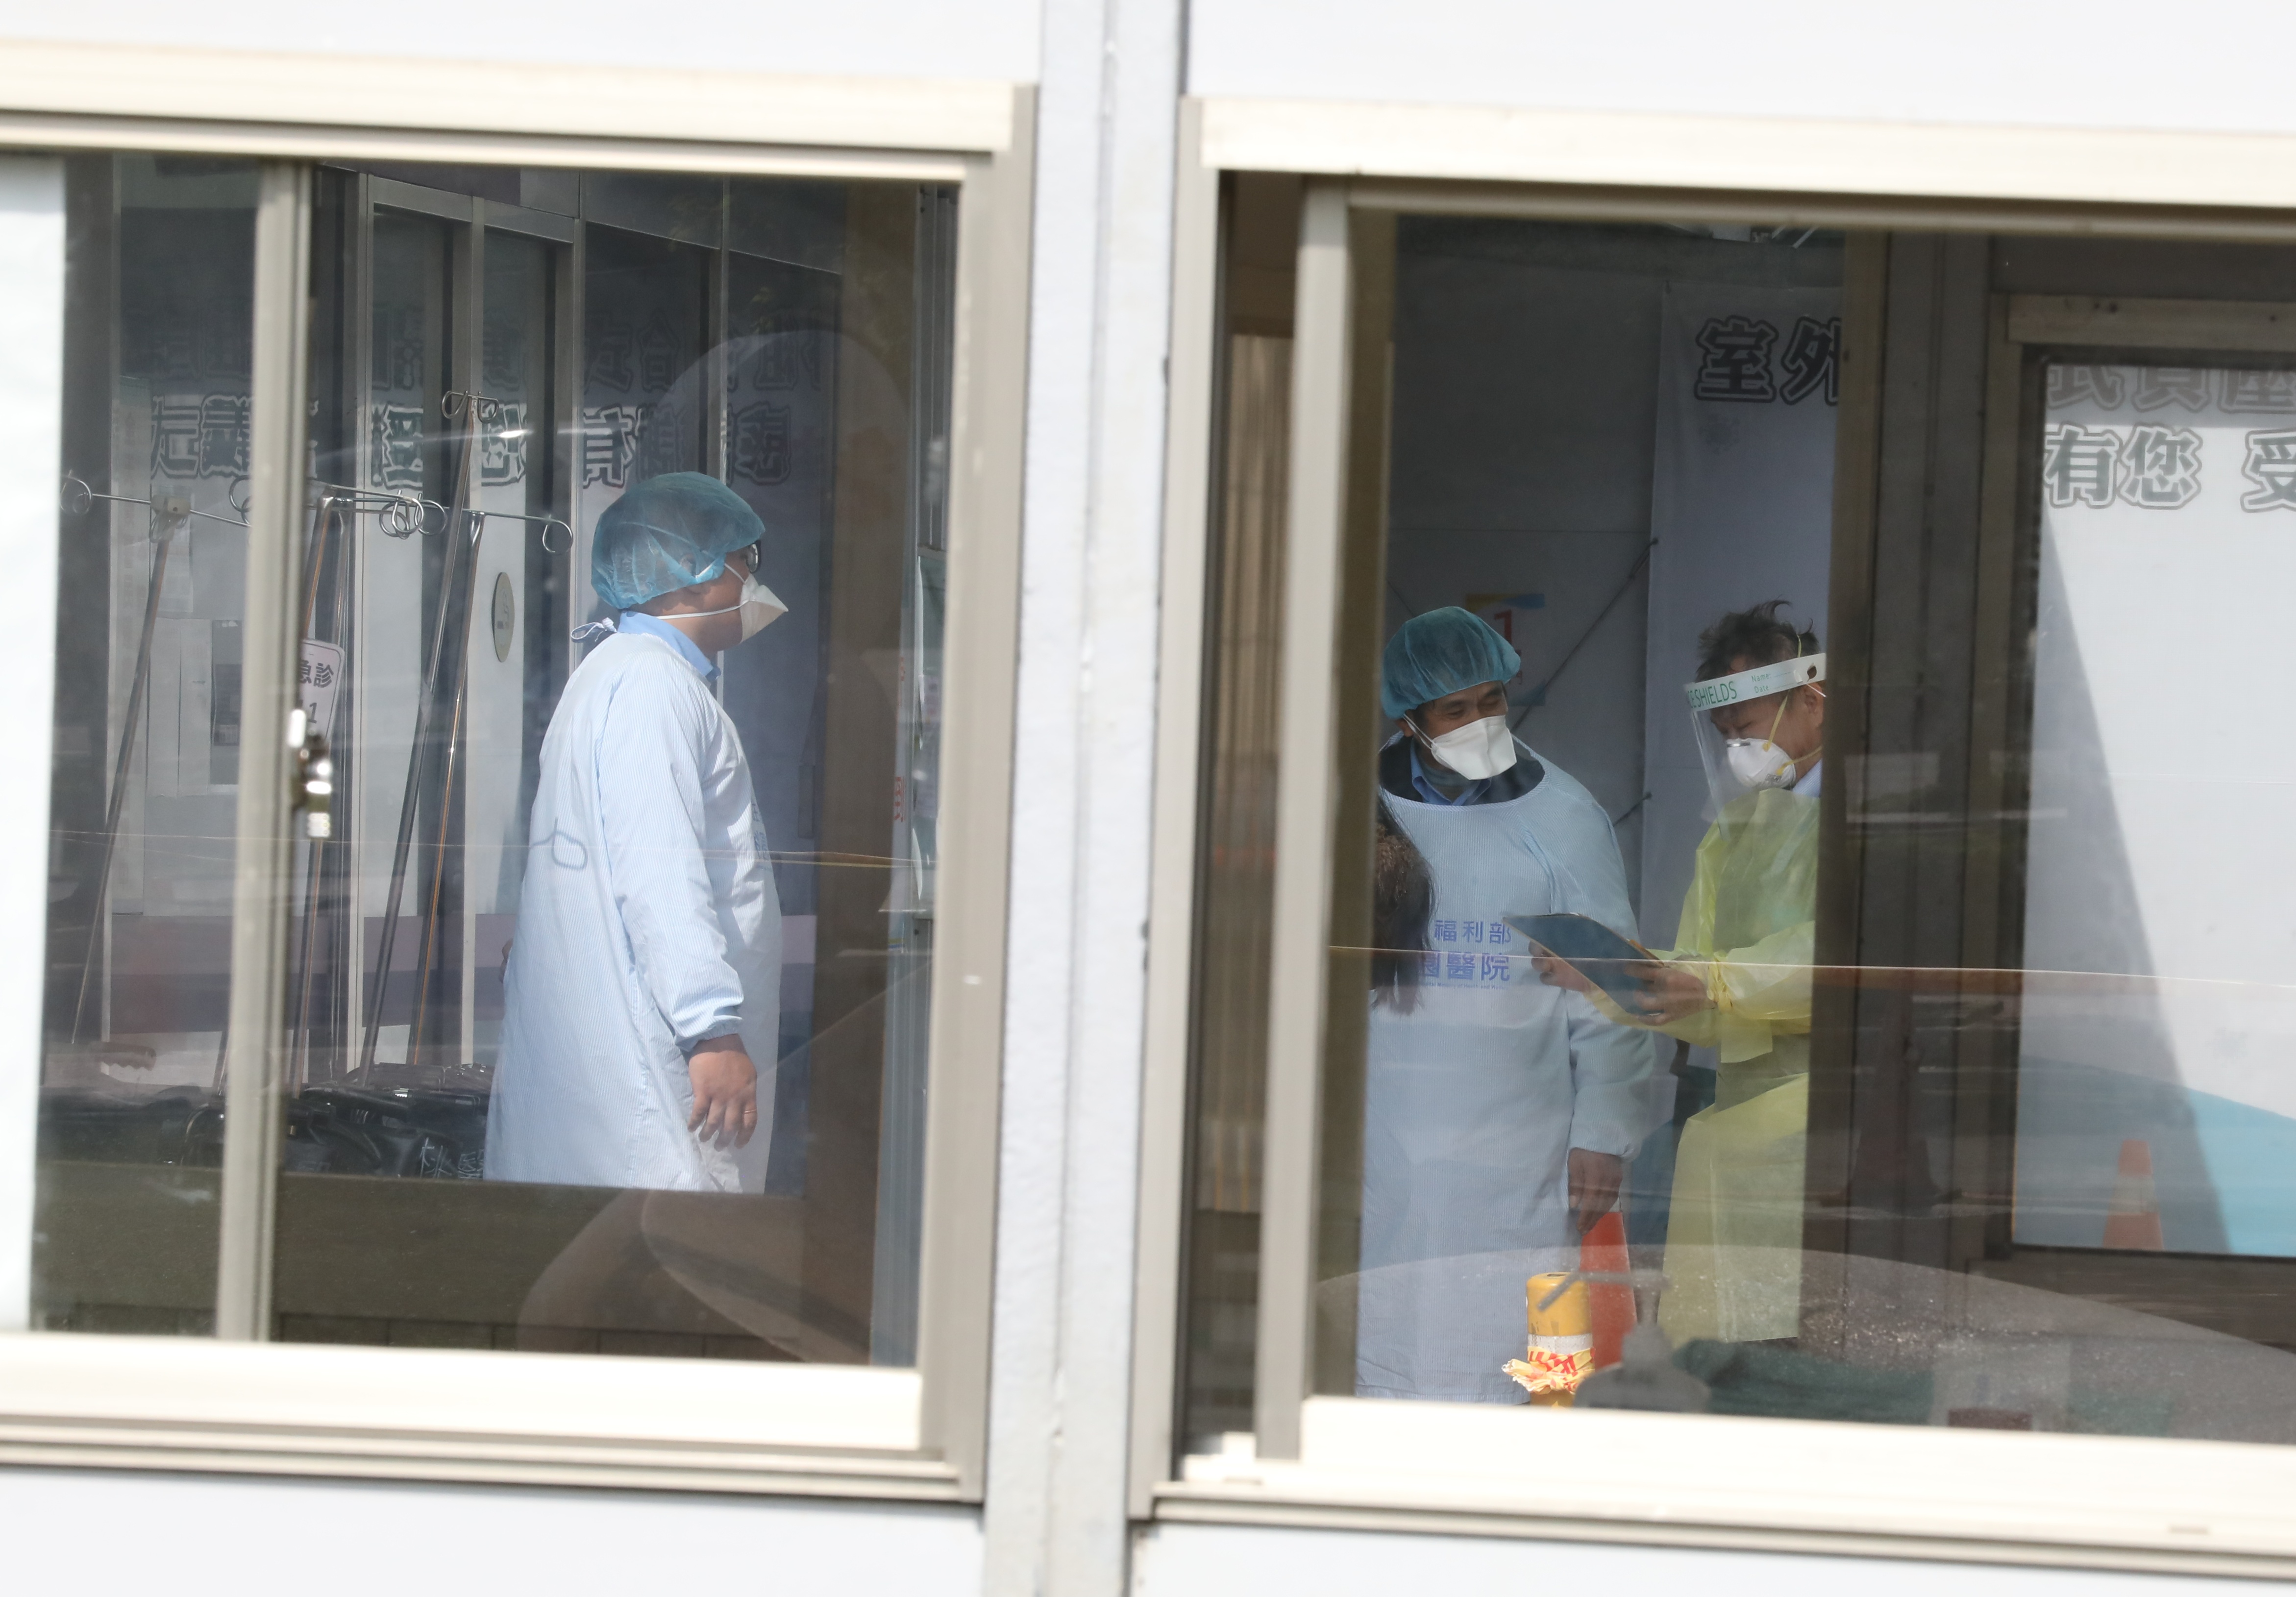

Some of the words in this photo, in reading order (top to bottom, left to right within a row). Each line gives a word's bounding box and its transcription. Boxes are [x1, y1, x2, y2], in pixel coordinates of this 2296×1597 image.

[1694, 315, 1841, 406] 室外
[2045, 421, 2203, 509] 有您
[1434, 920, 1511, 944] 福利部
